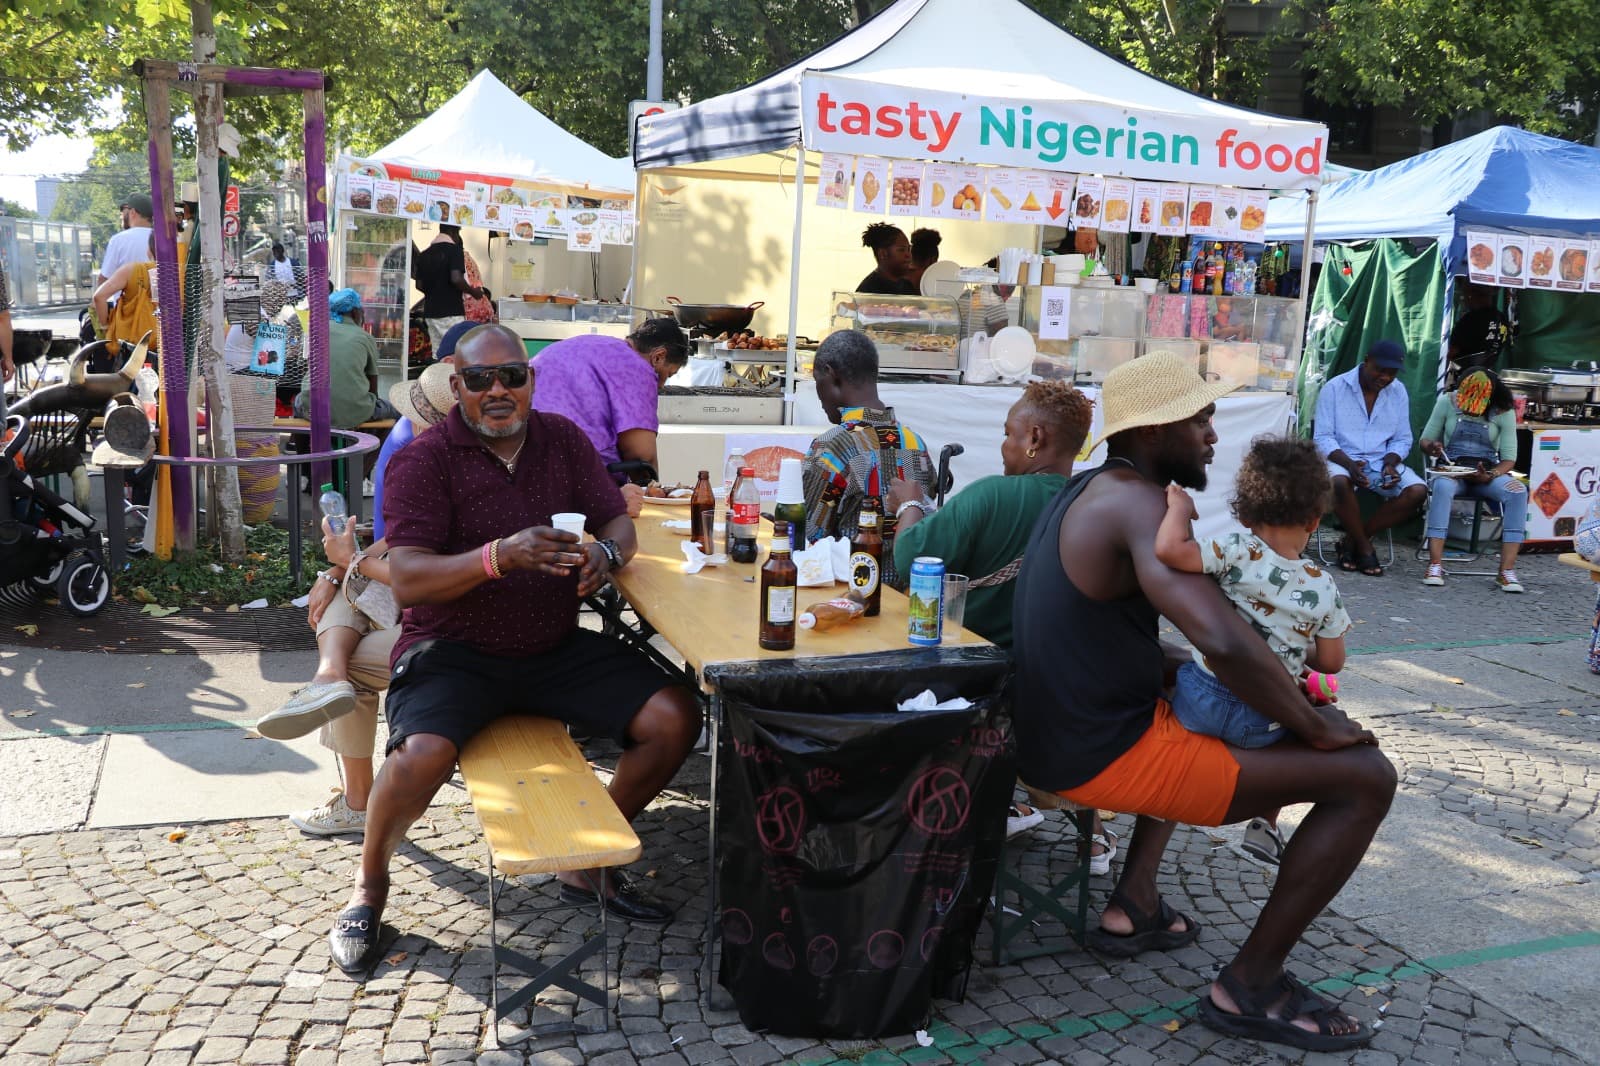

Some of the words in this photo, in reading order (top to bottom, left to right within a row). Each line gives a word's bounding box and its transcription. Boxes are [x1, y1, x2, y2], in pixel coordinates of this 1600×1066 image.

[817, 92, 962, 153] tasty
[980, 105, 1199, 166] Nigerian
[1216, 128, 1322, 176] food
